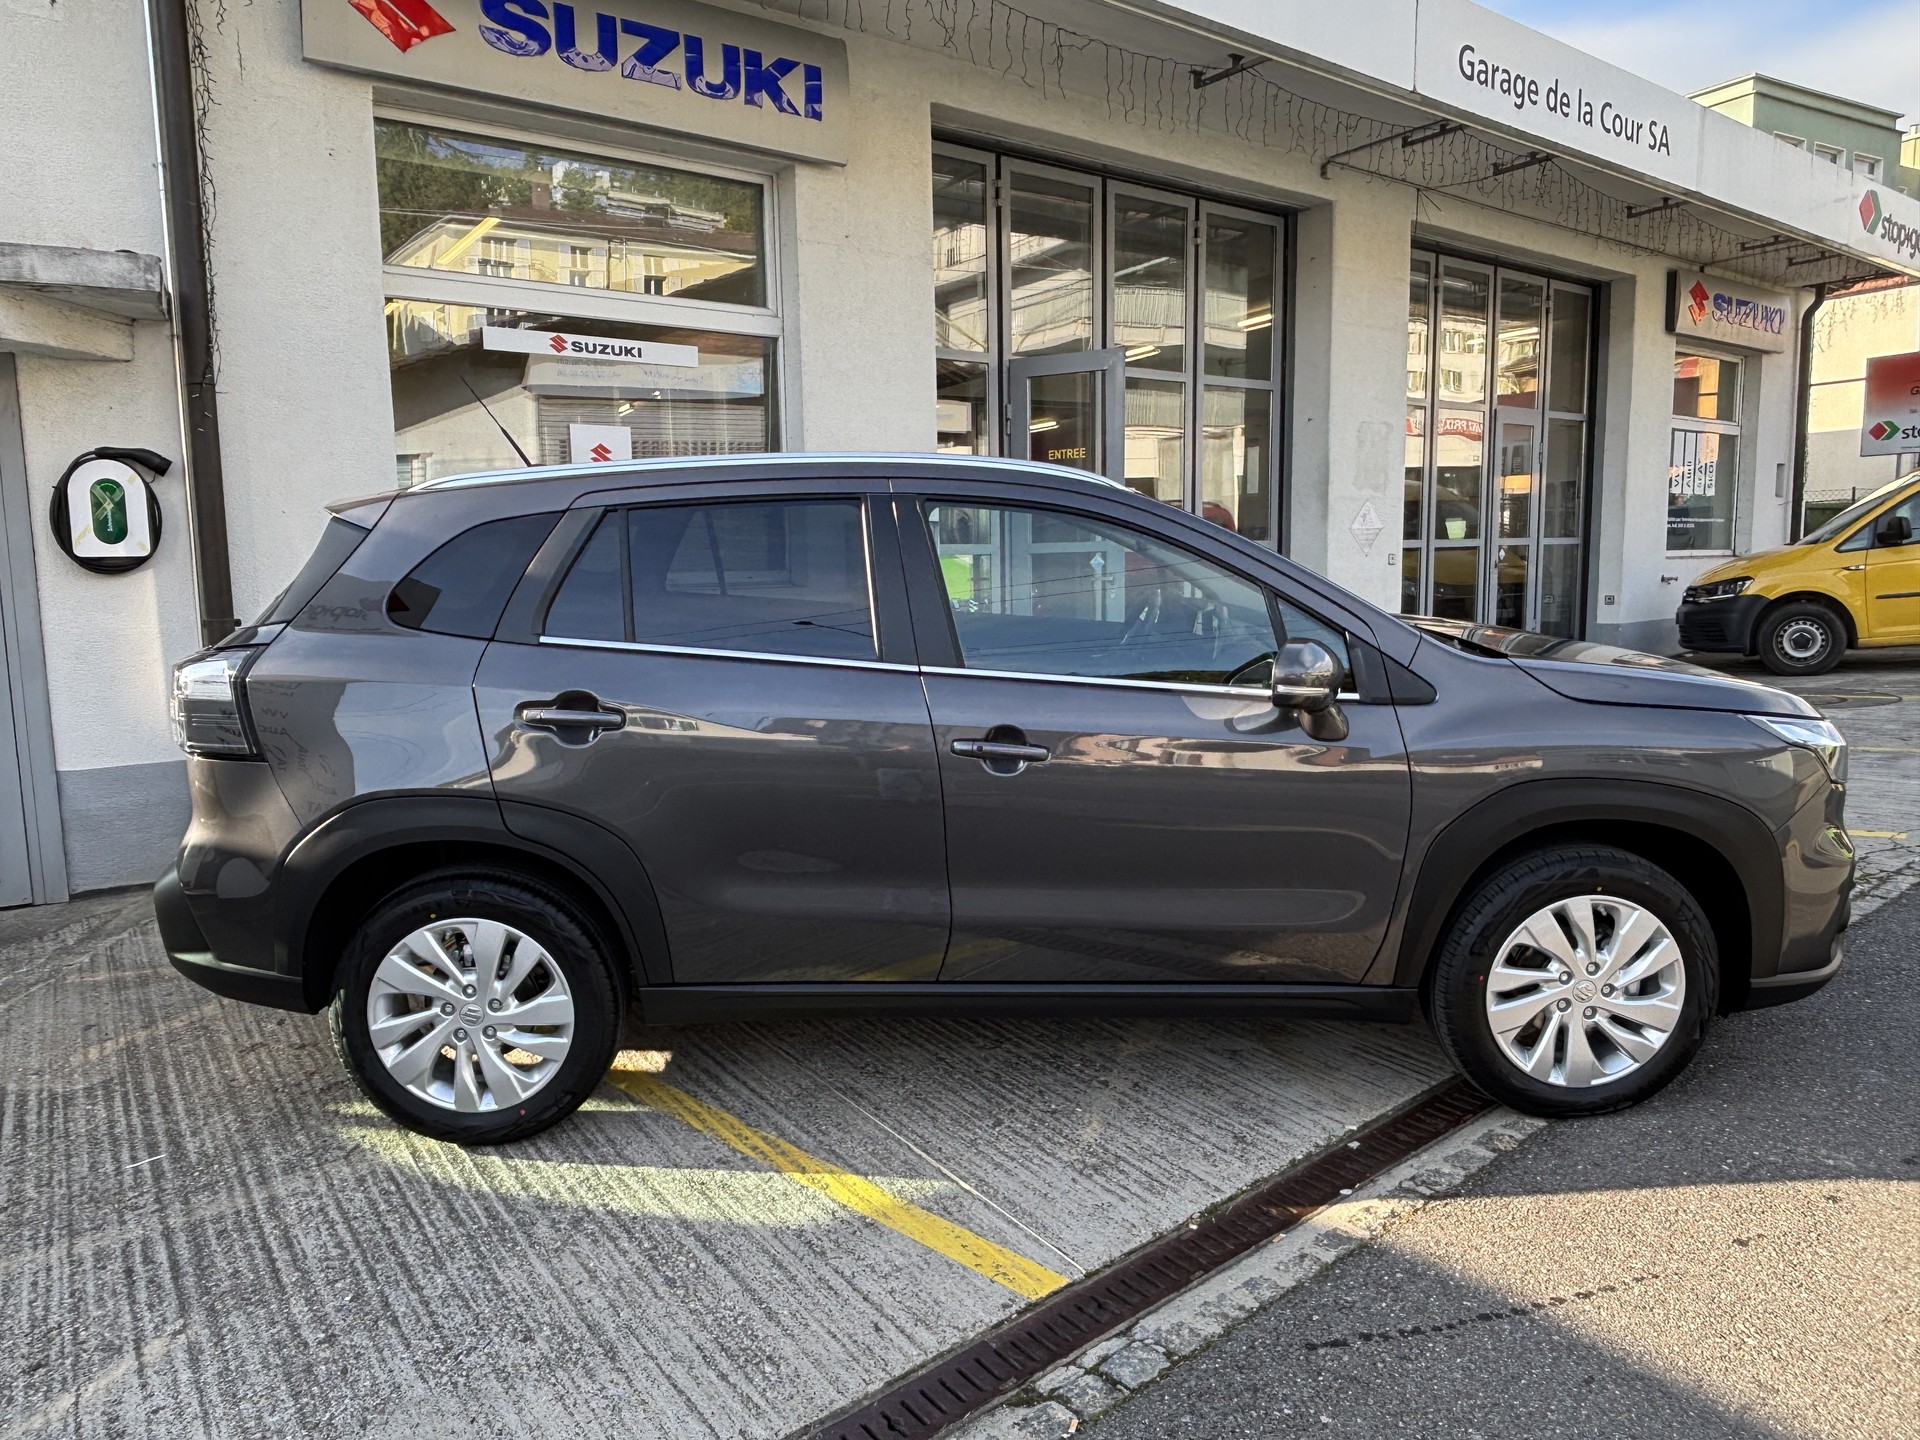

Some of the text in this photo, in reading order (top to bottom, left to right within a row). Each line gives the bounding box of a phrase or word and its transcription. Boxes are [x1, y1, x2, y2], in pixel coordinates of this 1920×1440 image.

[478, 0, 823, 122] SUZUKI
[1458, 44, 1671, 157] Garage de la Cour SA
[570, 340, 643, 359] SUZUKI
[1048, 447, 1086, 460] ENTREE
